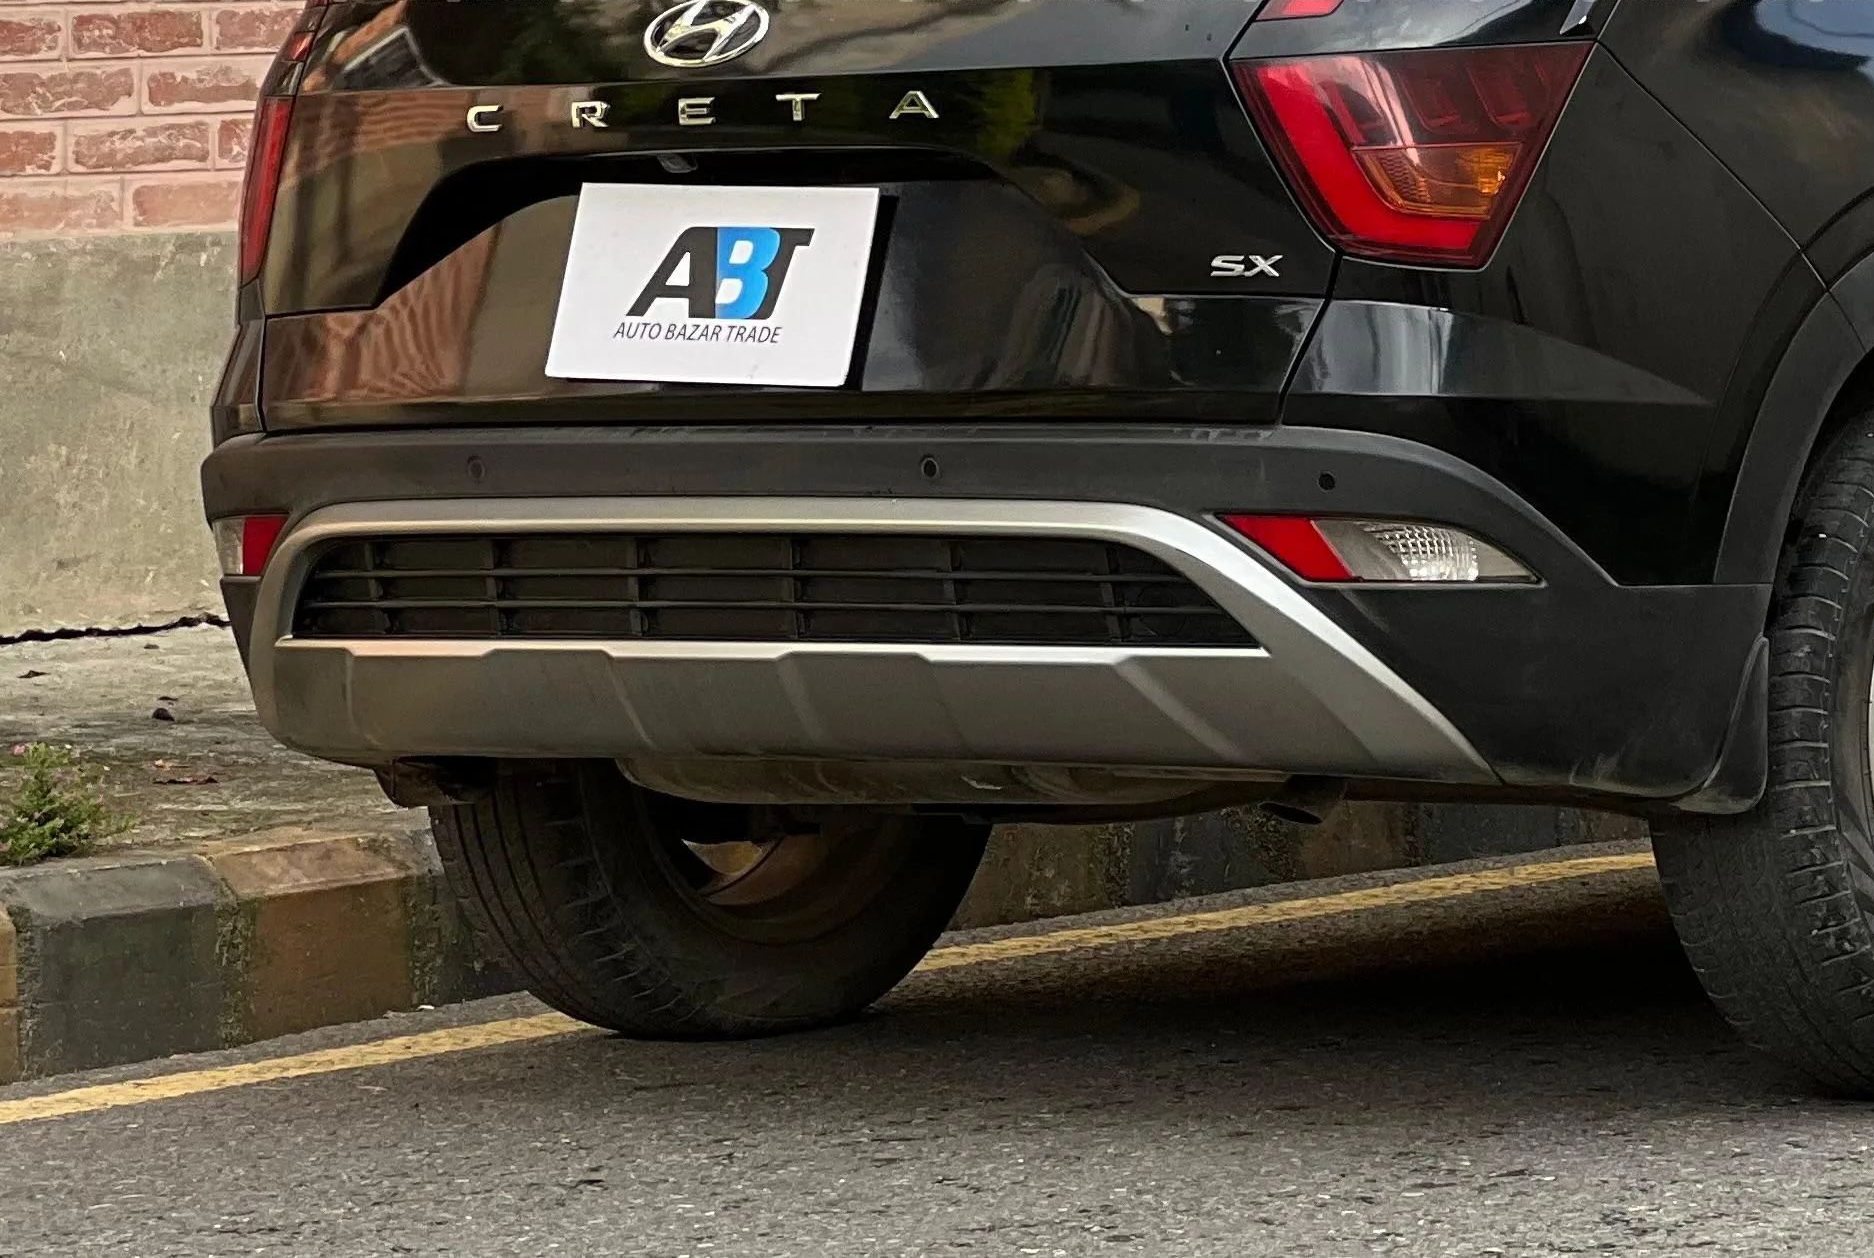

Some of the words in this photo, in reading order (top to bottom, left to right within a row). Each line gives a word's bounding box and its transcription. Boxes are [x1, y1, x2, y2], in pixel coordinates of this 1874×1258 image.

[466, 90, 940, 133] CRETA
[626, 226, 816, 320] ABT
[1210, 255, 1284, 277] SX
[613, 322, 662, 341] AUTO
[665, 324, 722, 343] BAZAR
[726, 326, 783, 344] TRADE
